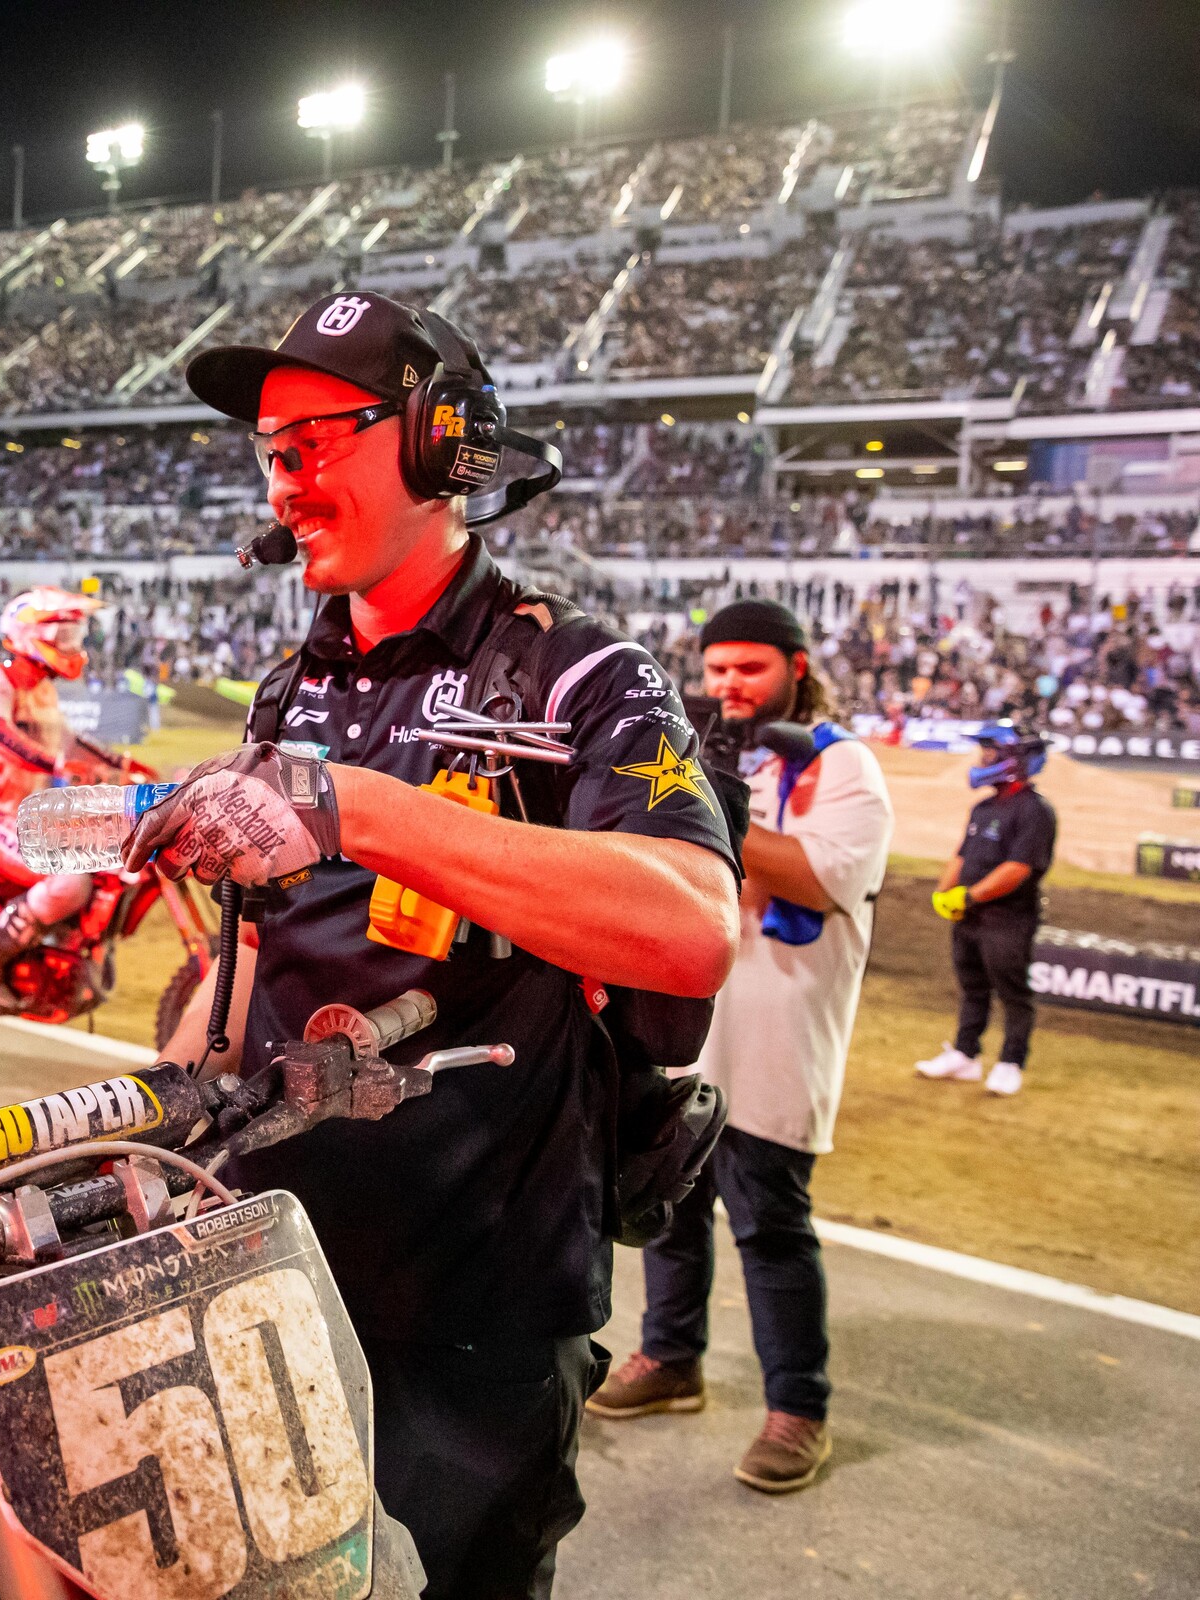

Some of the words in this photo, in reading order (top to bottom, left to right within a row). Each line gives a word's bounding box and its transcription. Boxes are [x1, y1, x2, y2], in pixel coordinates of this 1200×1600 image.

[389, 725, 422, 744] Hus
[1072, 734, 1200, 761] OAKLE
[211, 780, 286, 859] Mechanix
[195, 1201, 270, 1238] ROBERTSON
[43, 1268, 371, 1600] 50
